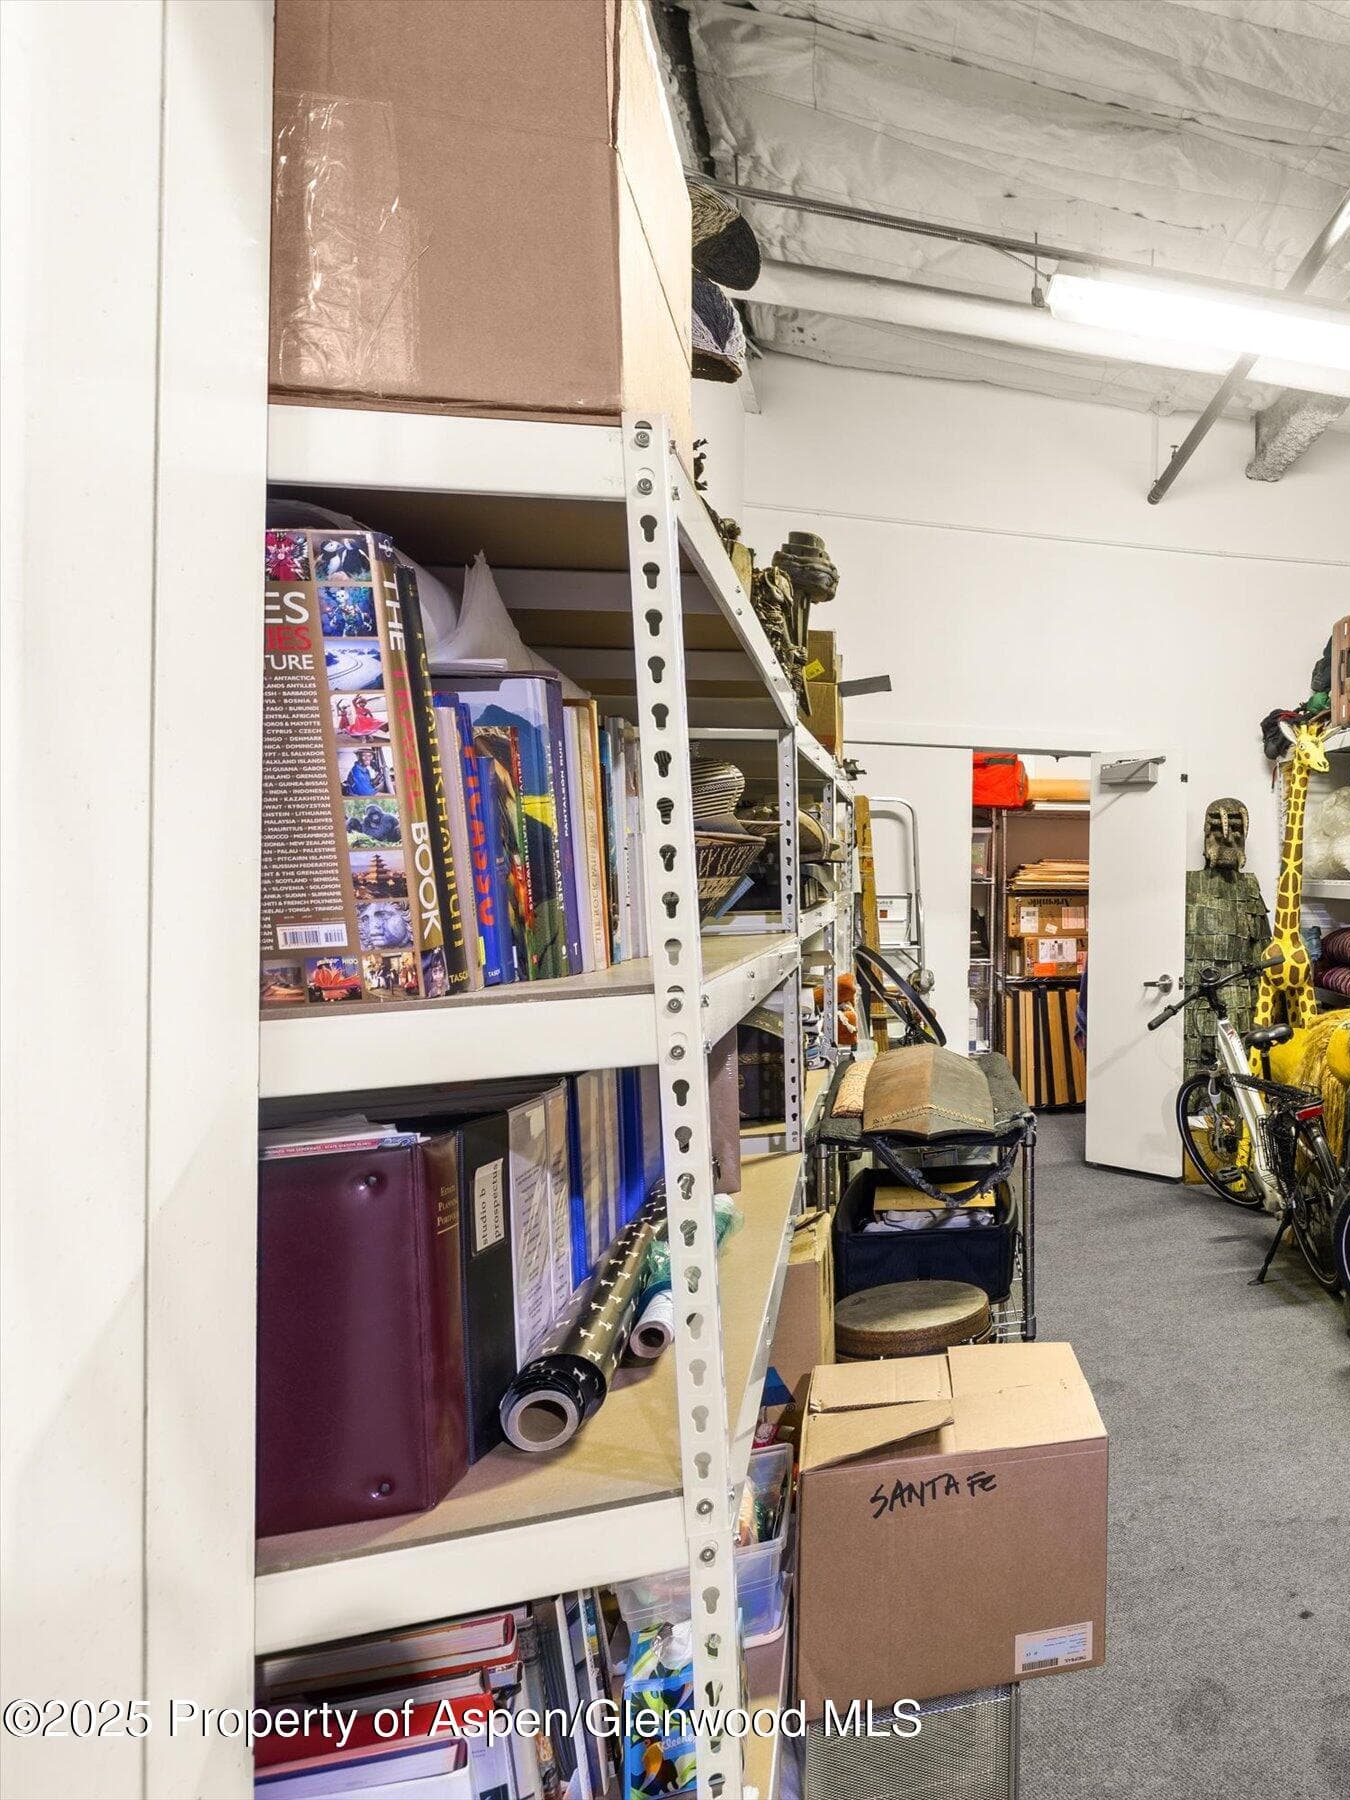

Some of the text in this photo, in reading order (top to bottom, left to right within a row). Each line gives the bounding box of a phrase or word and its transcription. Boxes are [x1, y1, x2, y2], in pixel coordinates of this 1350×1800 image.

[383, 573, 406, 651] THE
[411, 821, 442, 941] BOOK
[559, 769, 569, 837] PANTALEON
[521, 816, 535, 911] FEATHERWORKS
[554, 848, 566, 912] PLANET
[480, 1201, 489, 1246] studio
[492, 1163, 502, 1240] prospectus
[869, 1470, 998, 1519] SANTA FE
